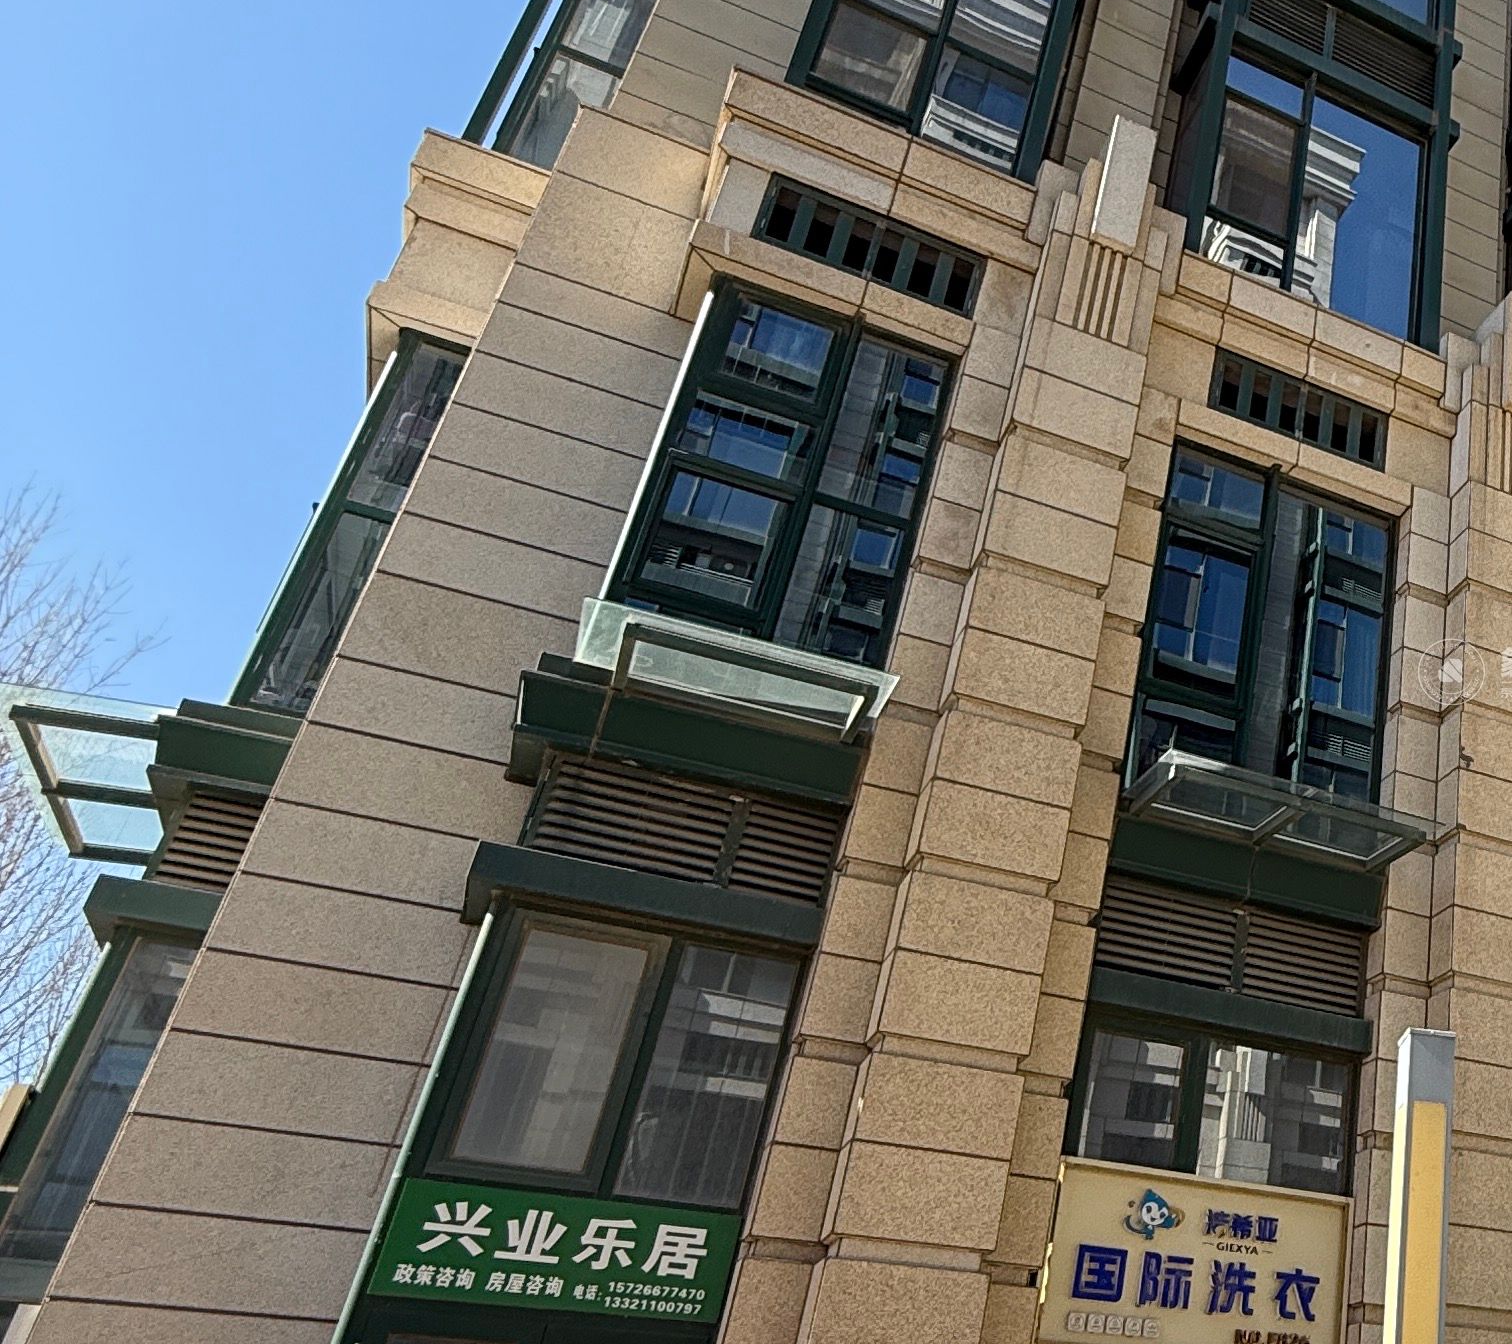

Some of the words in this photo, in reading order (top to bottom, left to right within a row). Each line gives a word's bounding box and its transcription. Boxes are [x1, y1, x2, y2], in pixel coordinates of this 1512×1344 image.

[416, 1201, 708, 1280] 兴业乐居
[392, 1263, 476, 1290] 政策咨询
[484, 1271, 564, 1298] 房屋咨询
[608, 1281, 706, 1302] 15726677470
[603, 1295, 702, 1316] 13321100797
[1071, 1243, 1321, 1322] 国际洗衣
